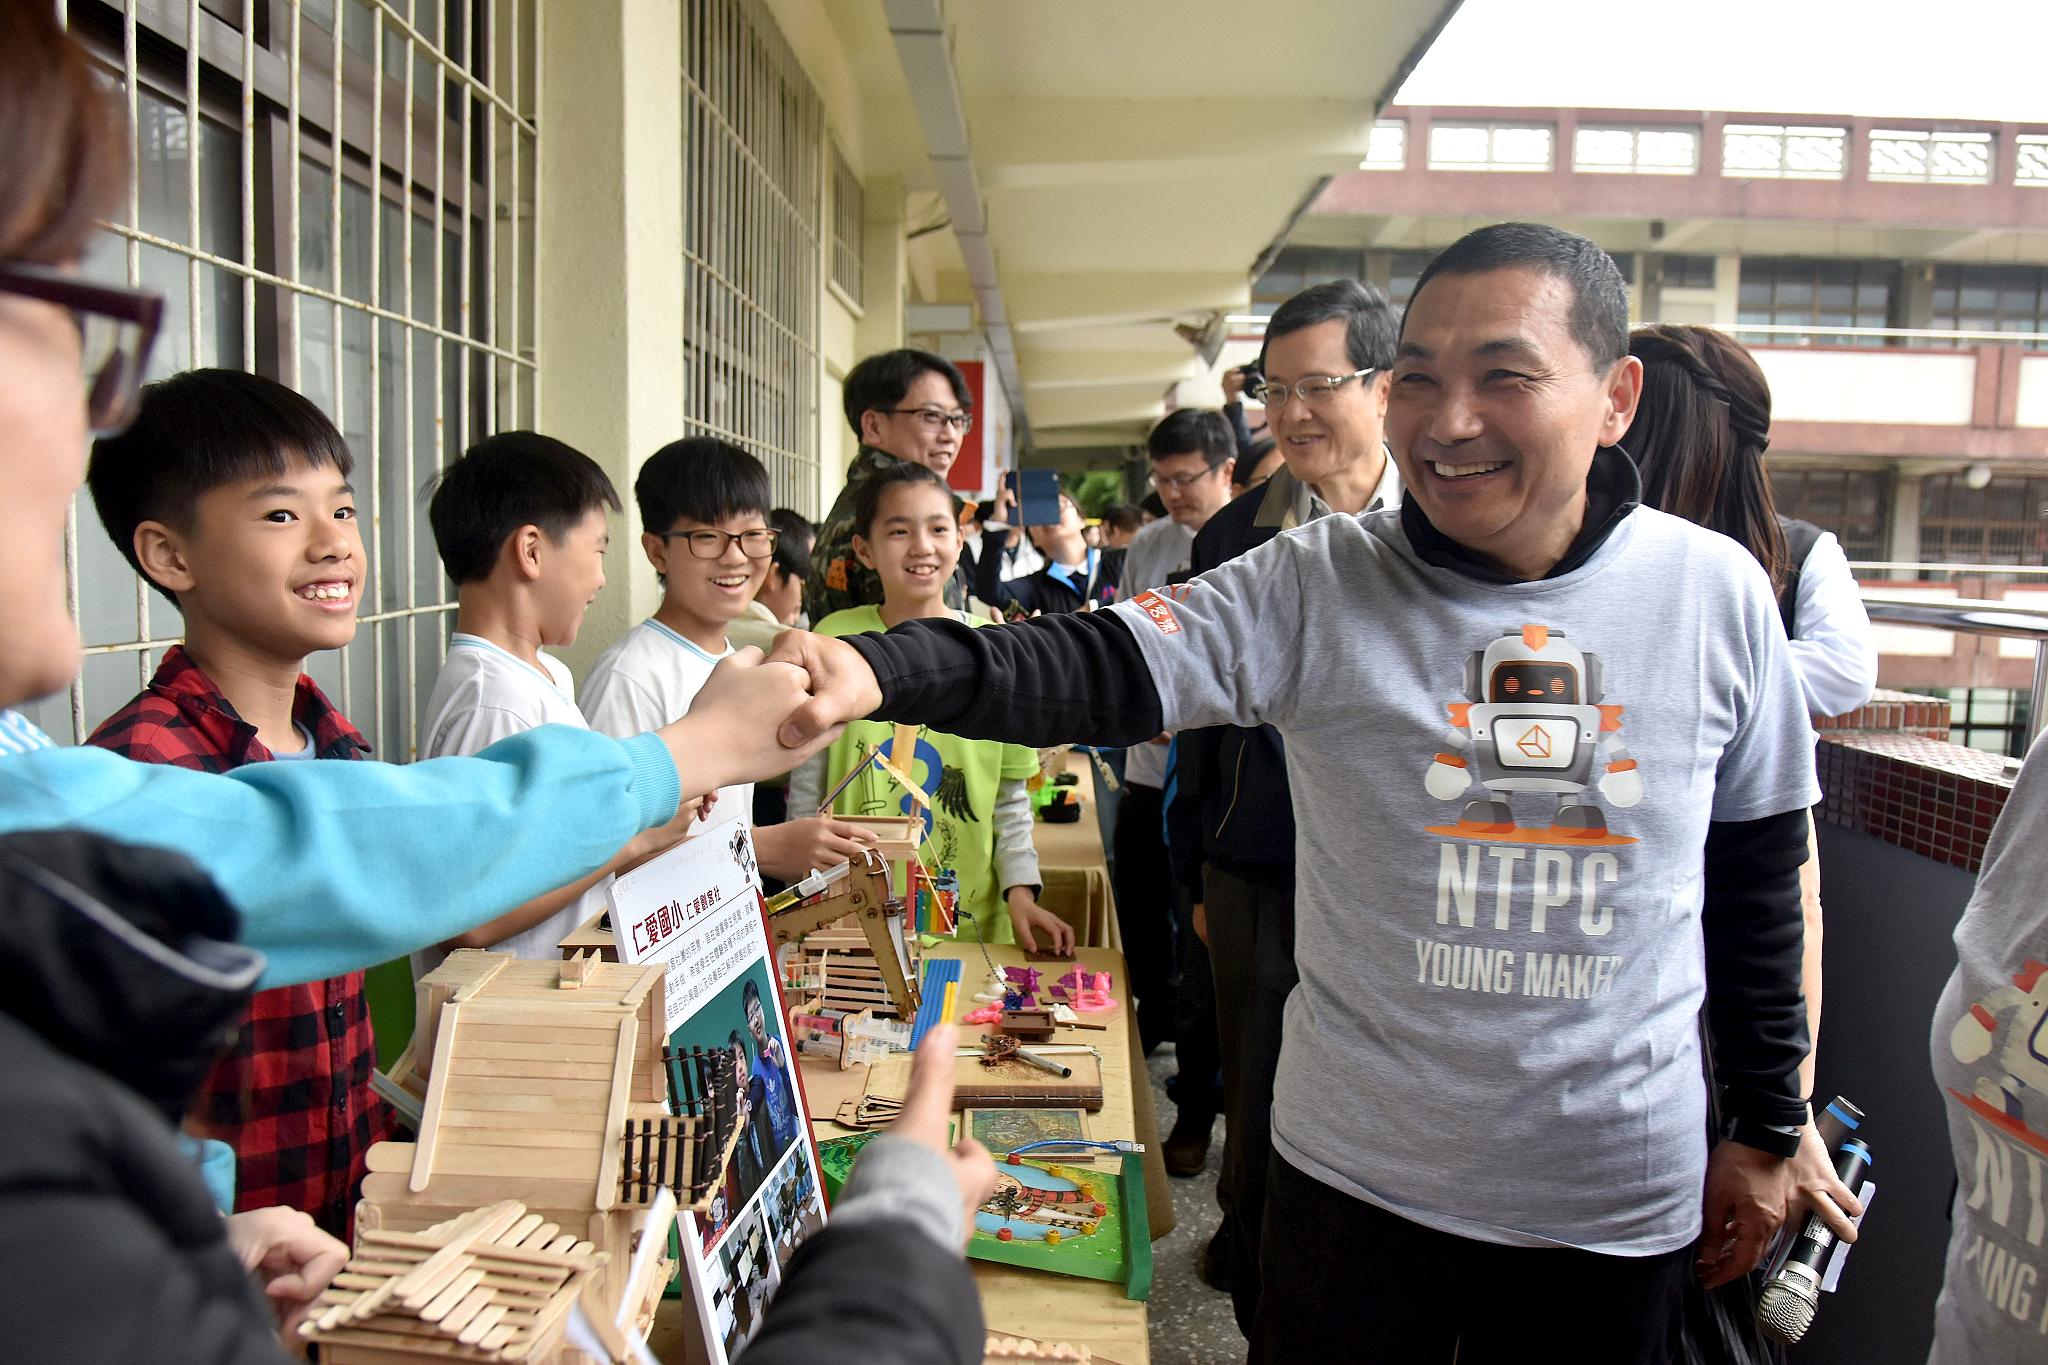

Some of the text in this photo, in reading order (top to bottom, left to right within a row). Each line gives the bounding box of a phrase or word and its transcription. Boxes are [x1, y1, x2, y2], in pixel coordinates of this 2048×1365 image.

[1436, 842, 1618, 936] NTPC
[632, 899, 684, 956] 仁愛國小
[1416, 938, 1515, 995] YOUNG
